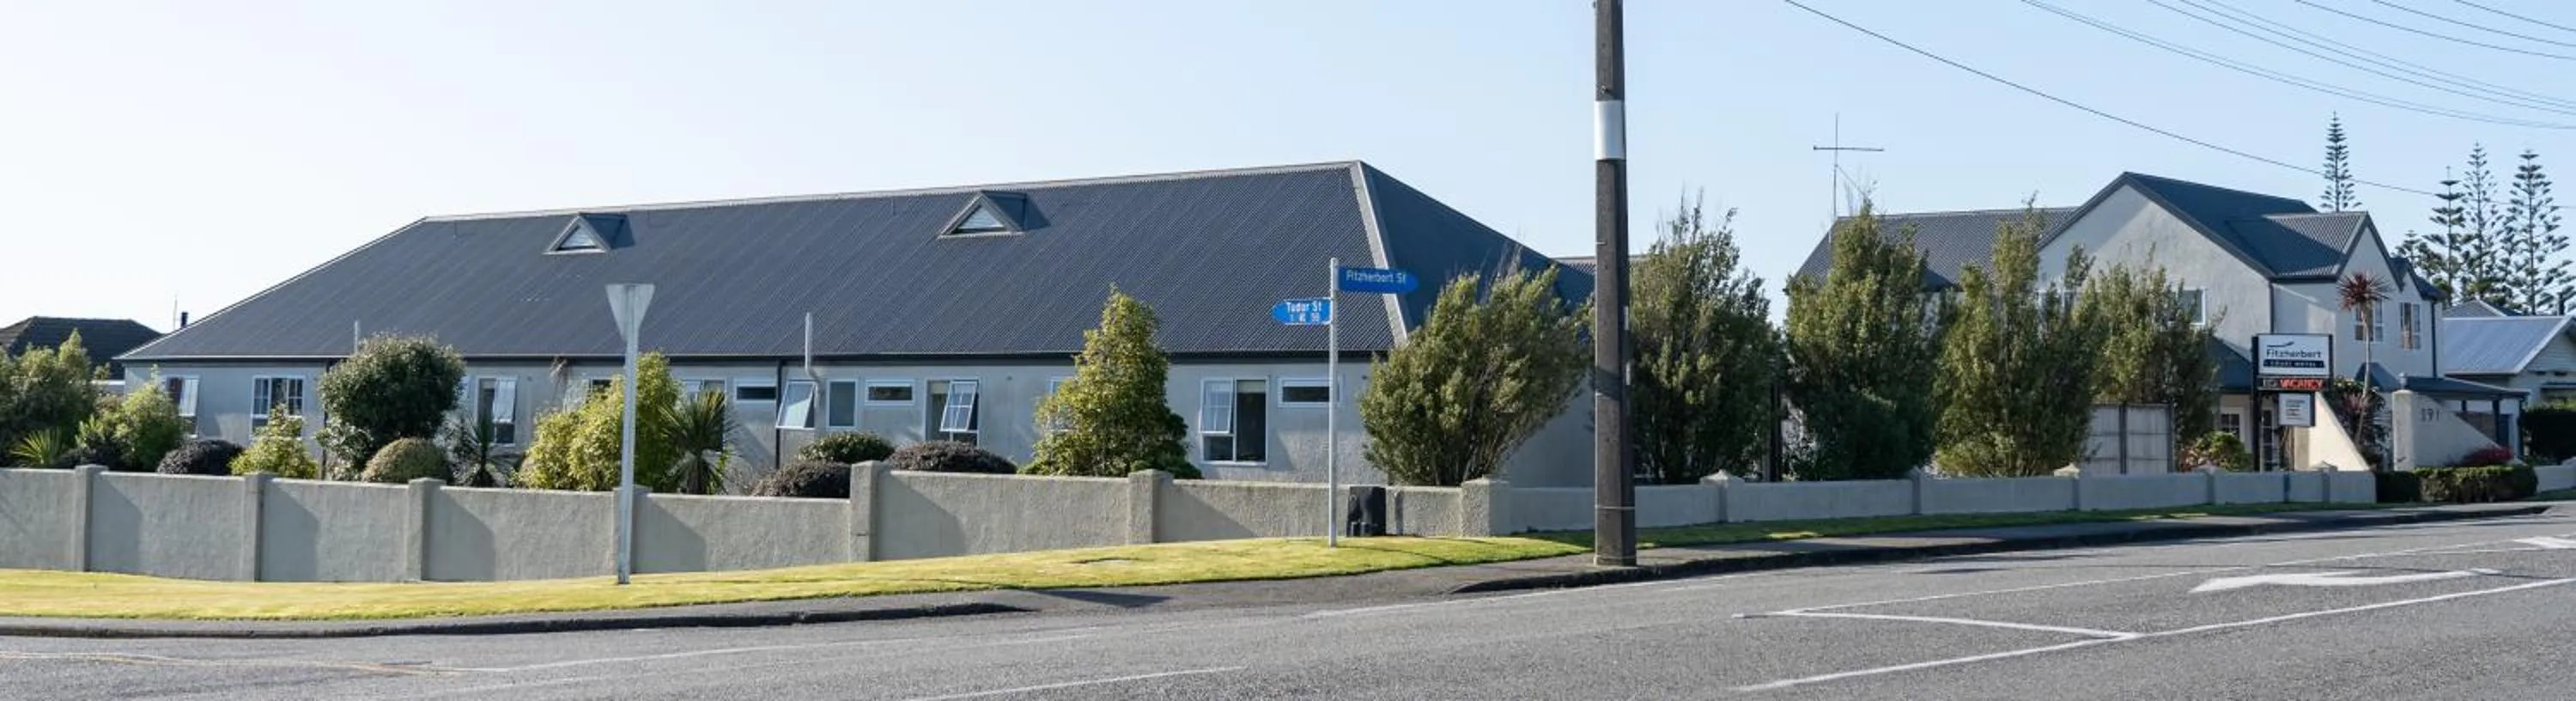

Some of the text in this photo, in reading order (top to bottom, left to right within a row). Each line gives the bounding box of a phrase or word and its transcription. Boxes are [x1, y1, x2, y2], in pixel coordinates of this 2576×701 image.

[1346, 269, 1406, 284] Fitzherbert St
[1286, 301, 1322, 313] Tudor St
[2266, 349, 2322, 358] Fitzherbert
[2280, 378, 2323, 389] VACANCY
